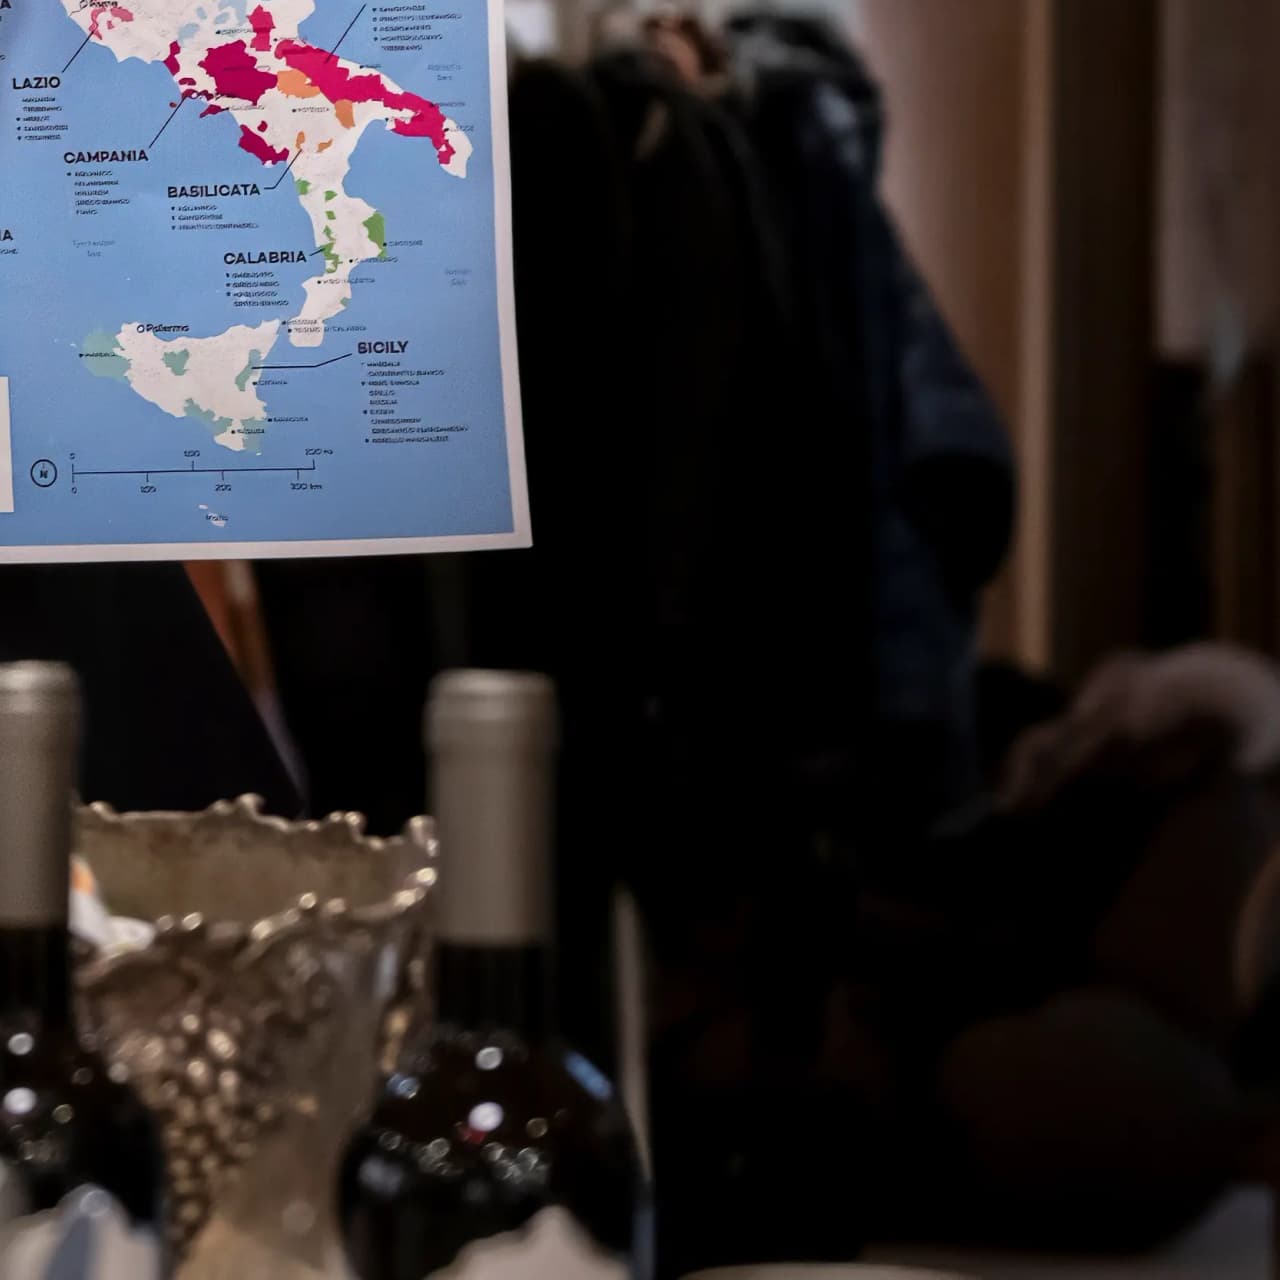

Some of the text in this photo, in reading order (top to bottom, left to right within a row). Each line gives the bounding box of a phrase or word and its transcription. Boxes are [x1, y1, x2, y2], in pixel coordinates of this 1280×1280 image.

[12, 76, 61, 90] LAZIO
[64, 149, 149, 164] CAMPANIA
[167, 183, 261, 198] BASILICATA
[223, 251, 307, 265] CALABRIA
[357, 340, 409, 354] SICILY
